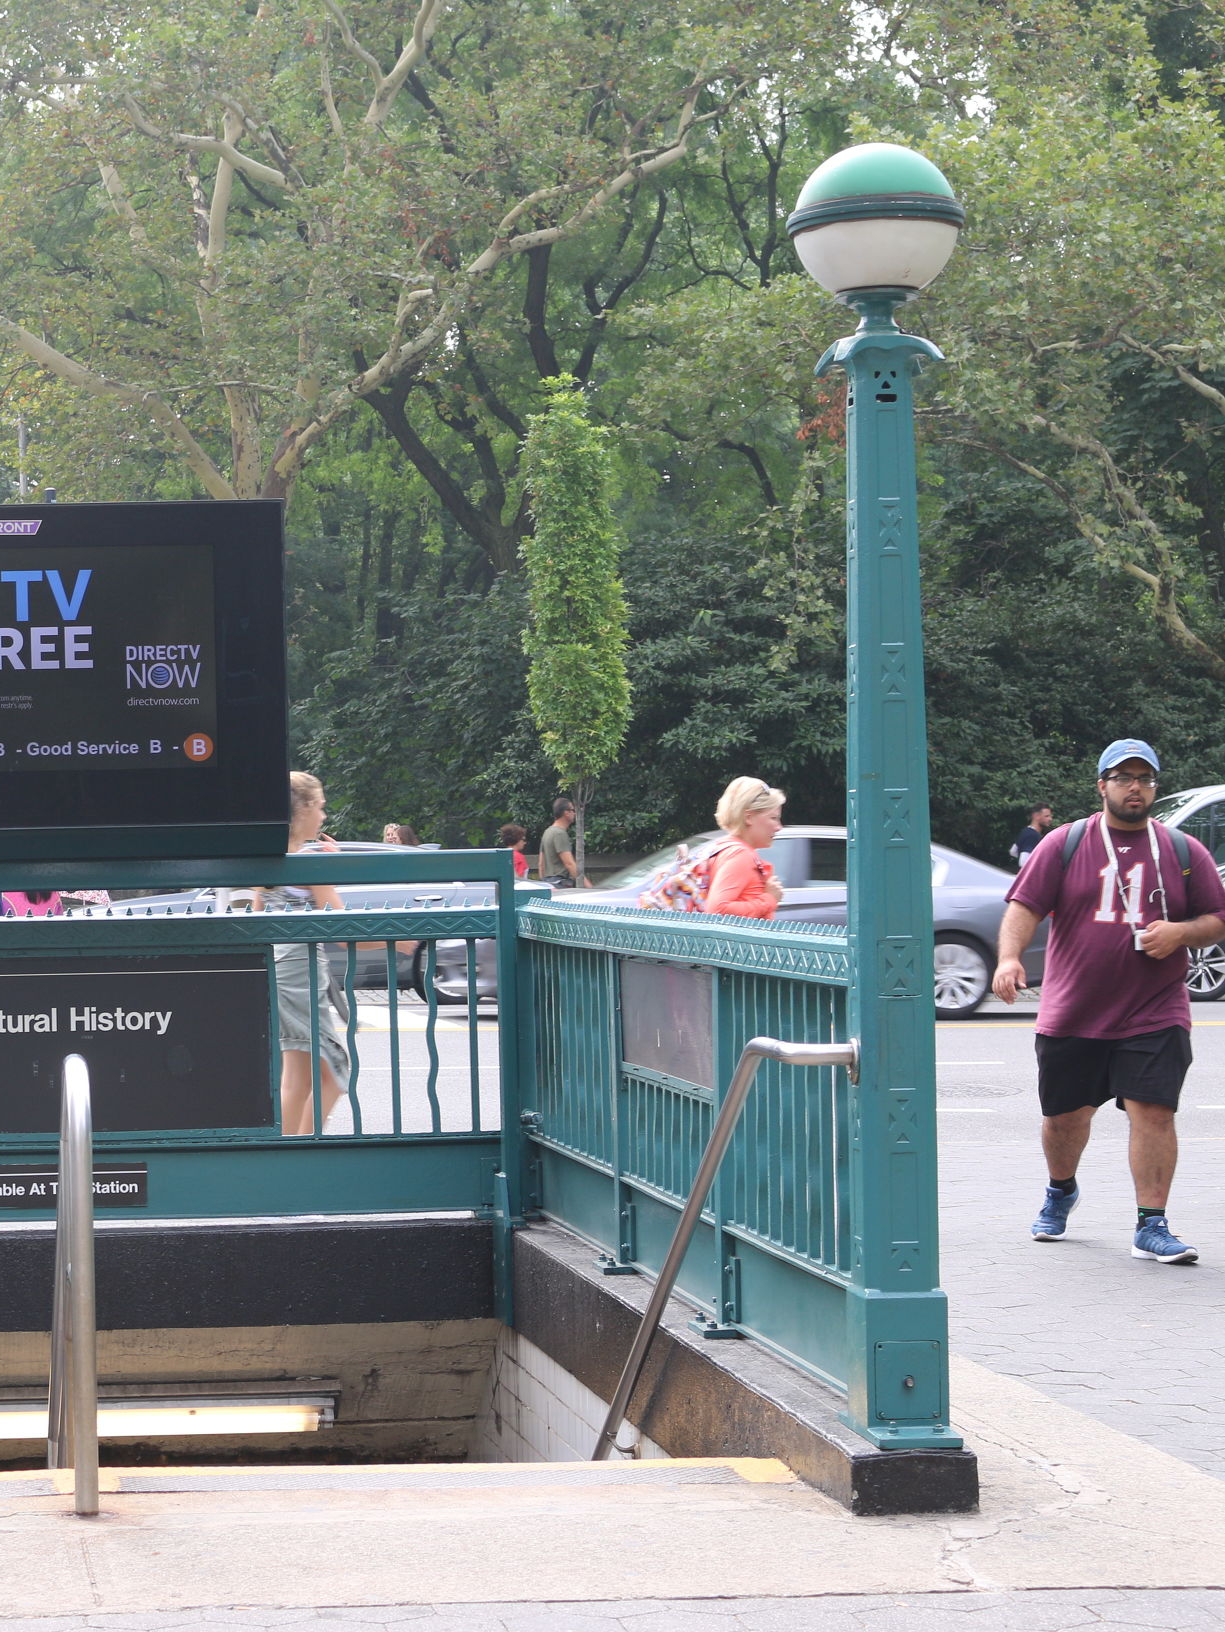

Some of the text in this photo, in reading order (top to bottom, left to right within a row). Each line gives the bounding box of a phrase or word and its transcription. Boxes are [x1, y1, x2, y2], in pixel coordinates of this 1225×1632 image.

[0, 569, 94, 622] TV
[126, 644, 201, 660] DIRECTV
[126, 662, 201, 689] NOW
[127, 697, 200, 707] directvnow.com
[26, 741, 72, 756] Good
[77, 740, 139, 756] Service
[150, 739, 162, 754] B
[192, 738, 207, 756] B
[1093, 861, 1145, 925] 11
[70, 1006, 173, 1035] History
[29, 1181, 46, 1196] At
